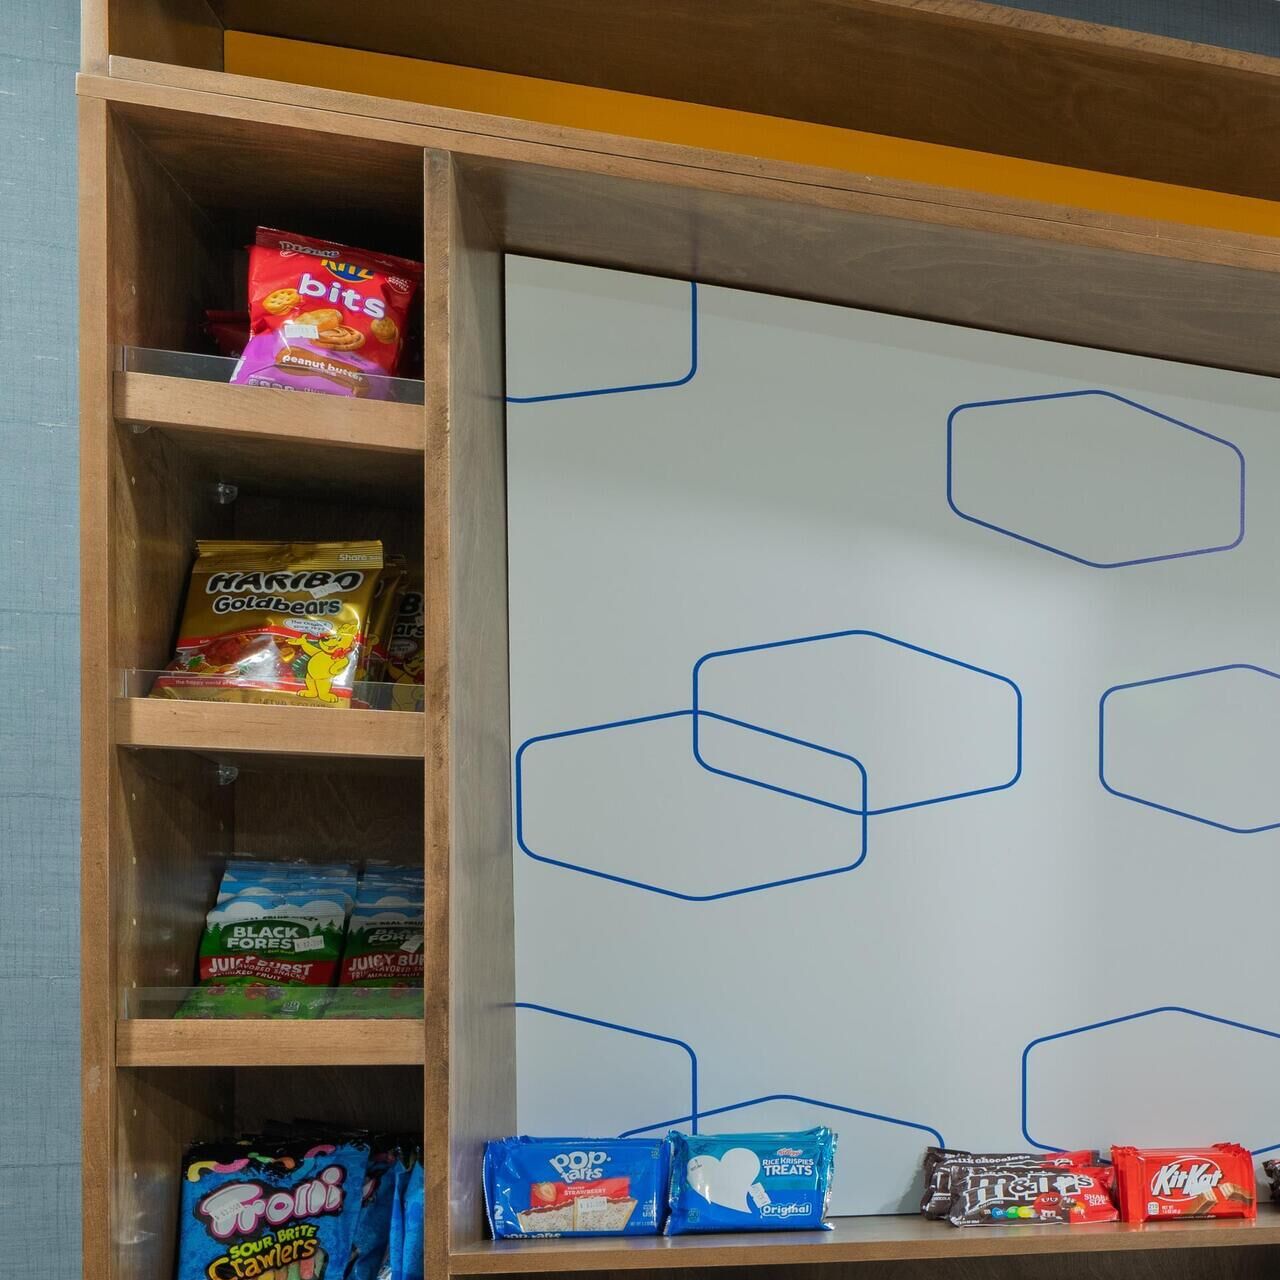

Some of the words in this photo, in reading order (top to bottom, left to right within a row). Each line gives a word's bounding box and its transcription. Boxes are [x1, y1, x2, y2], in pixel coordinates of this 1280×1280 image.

[298, 273, 385, 319] bits
[282, 354, 325, 370] peanut
[327, 362, 363, 381] butter
[206, 571, 363, 594] HARIBO
[213, 596, 343, 615] Goldbears
[233, 926, 299, 938] BLACK
[762, 1157, 780, 1165] RICE
[780, 1157, 814, 1165] KRISPIES
[764, 1165, 813, 1176] TREATS
[202, 1167, 342, 1236] Trolli
[762, 1203, 809, 1217] Original
[230, 1237, 272, 1259] SOUR
